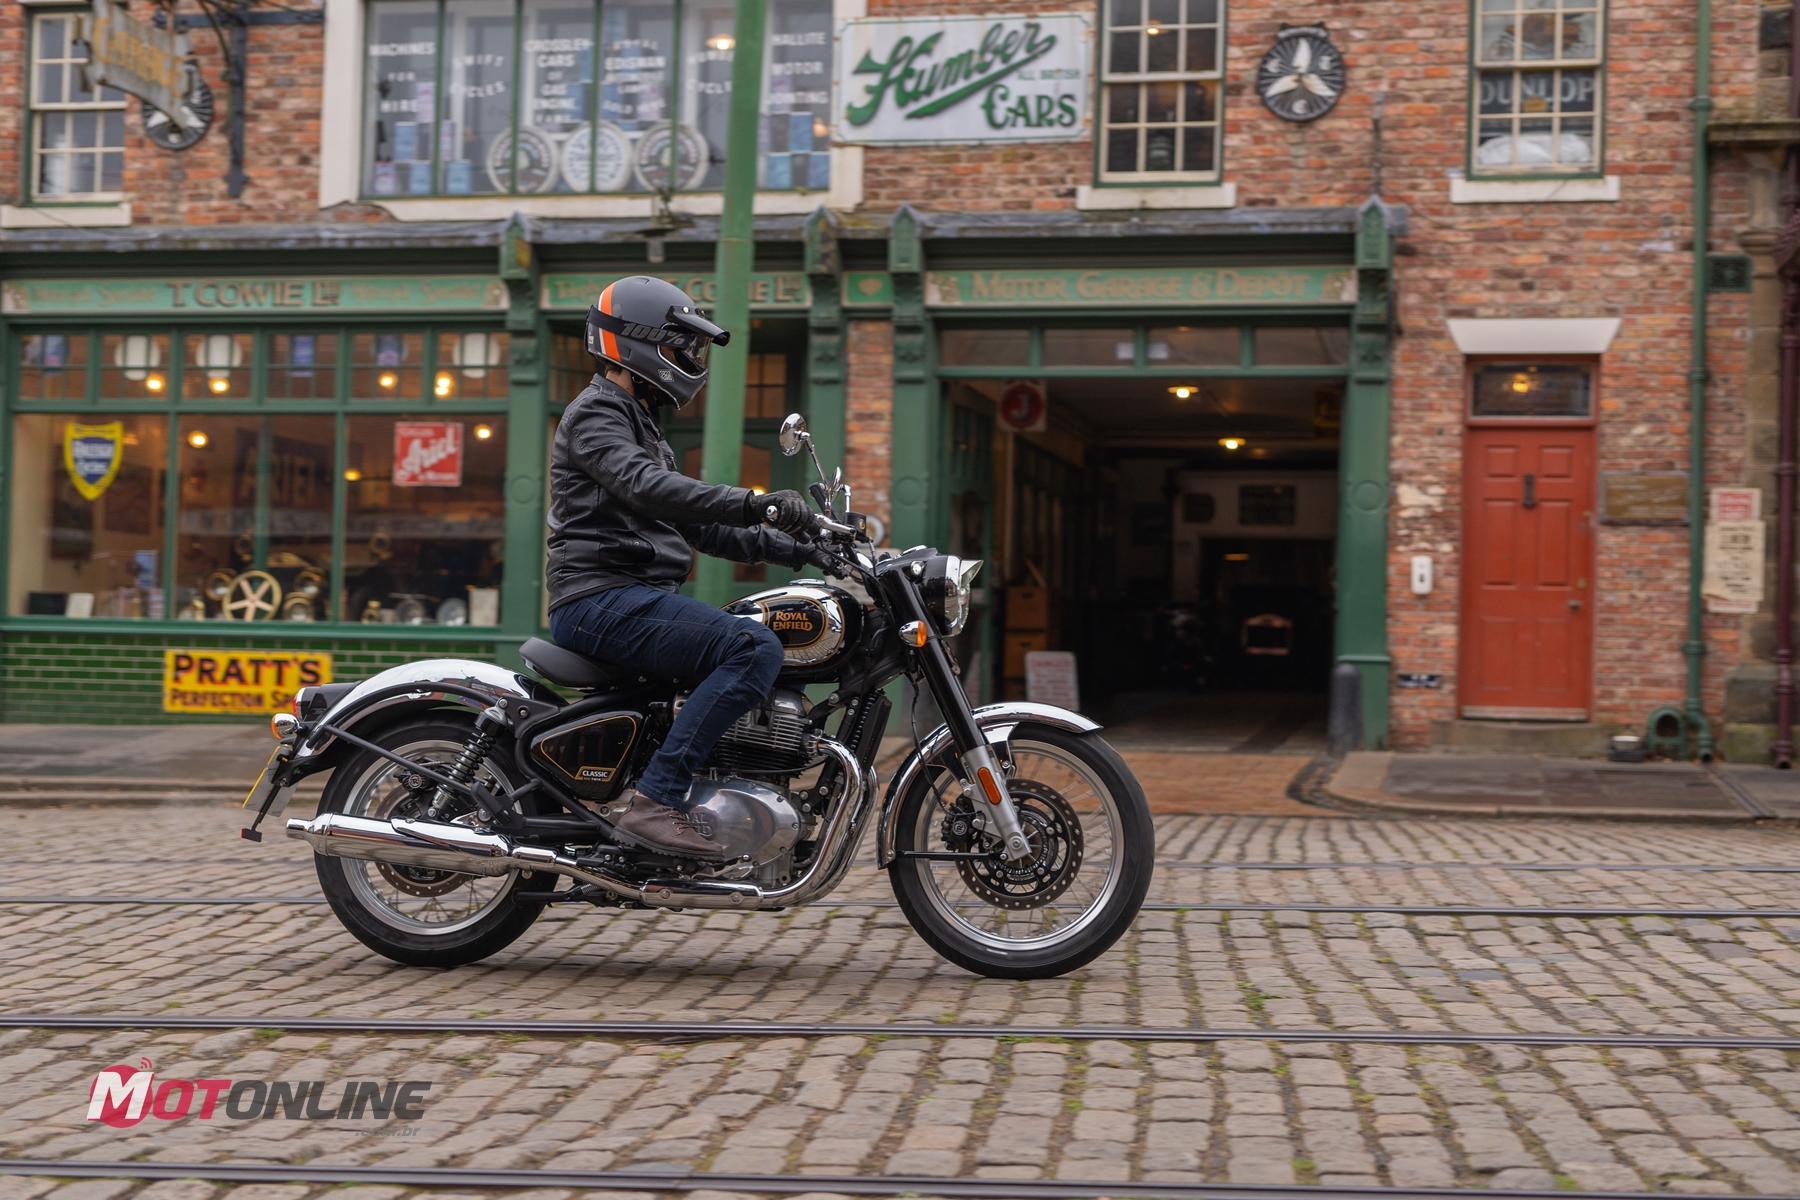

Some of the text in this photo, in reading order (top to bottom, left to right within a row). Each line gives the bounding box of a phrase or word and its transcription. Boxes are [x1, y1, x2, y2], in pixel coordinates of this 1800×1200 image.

[368, 42, 436, 57] MACHINES
[537, 54, 576, 68] CARS
[847, 22, 1057, 126] Humber
[1478, 76, 1594, 105] DUNLOP
[981, 85, 1077, 129] CARS
[195, 279, 305, 307] COWIE
[973, 272, 1068, 299] MOTOR
[1076, 270, 1184, 298] GARAGE
[621, 322, 686, 346] 100%
[773, 621, 813, 631] ENFIELD
[776, 611, 809, 621] ROYAL
[173, 653, 321, 687] PRATT'S
[582, 769, 608, 778] CLASSIC
